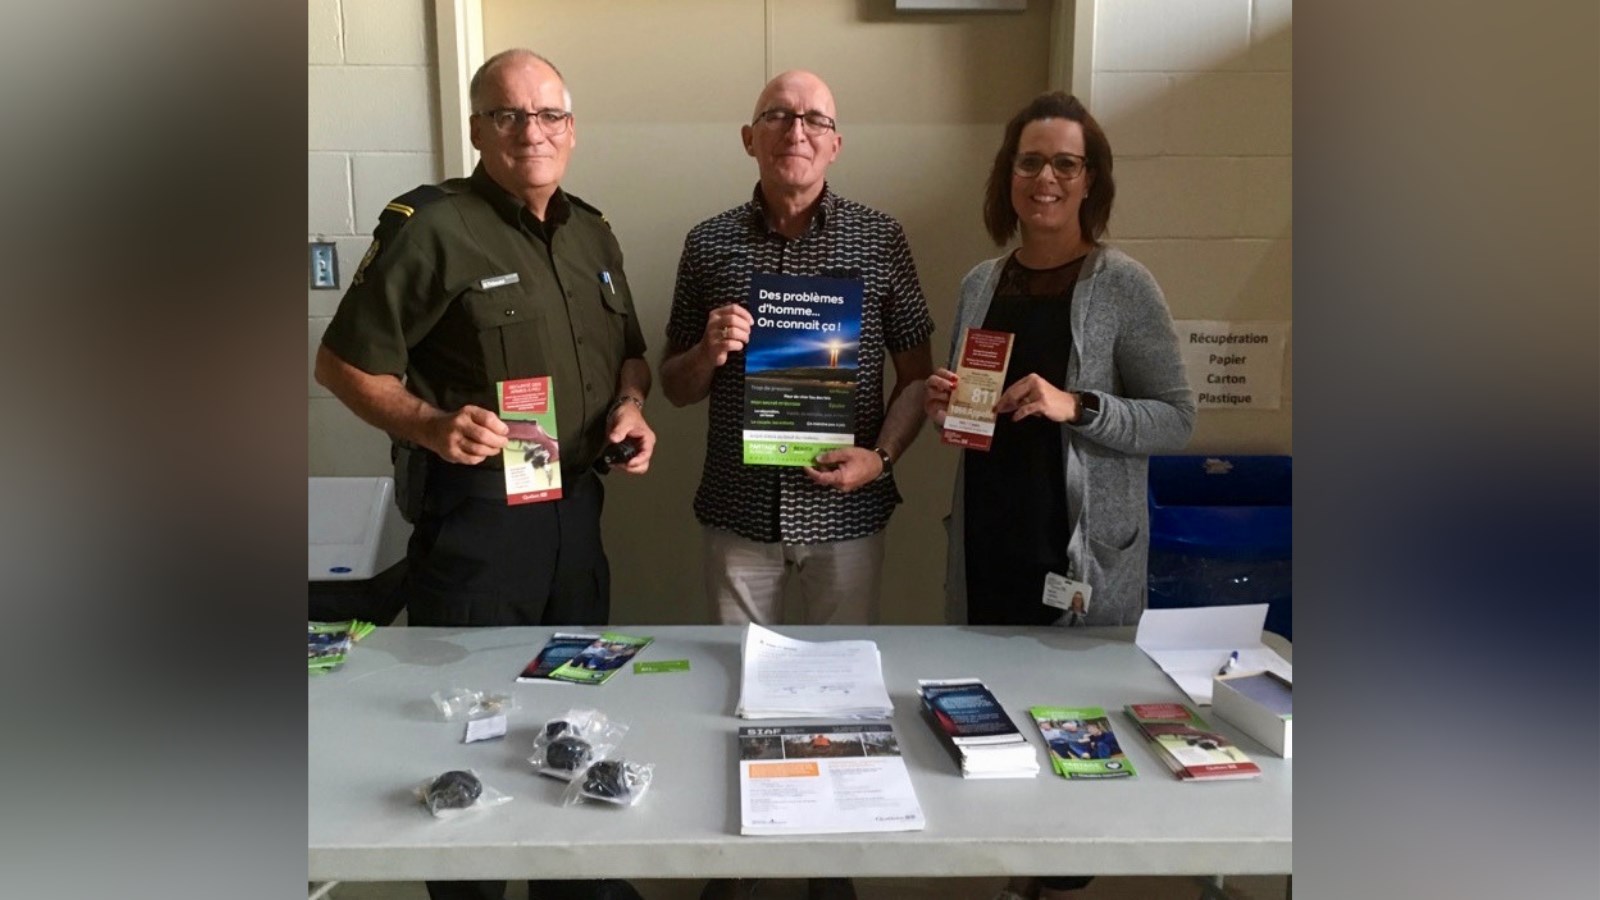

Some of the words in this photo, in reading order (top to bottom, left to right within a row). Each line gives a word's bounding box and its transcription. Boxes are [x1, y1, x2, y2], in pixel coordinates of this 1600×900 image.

[759, 289, 781, 300] Des
[783, 292, 844, 304] problèmes
[758, 303, 820, 317] d'homme...
[757, 317, 774, 328] On
[776, 320, 820, 330] connait
[821, 323, 836, 333] ça
[1189, 333, 1269, 346] Récupération
[1209, 354, 1247, 366] Papier
[1207, 373, 1246, 384] Carton
[971, 388, 997, 406] 811
[1198, 392, 1252, 405] Plastique
